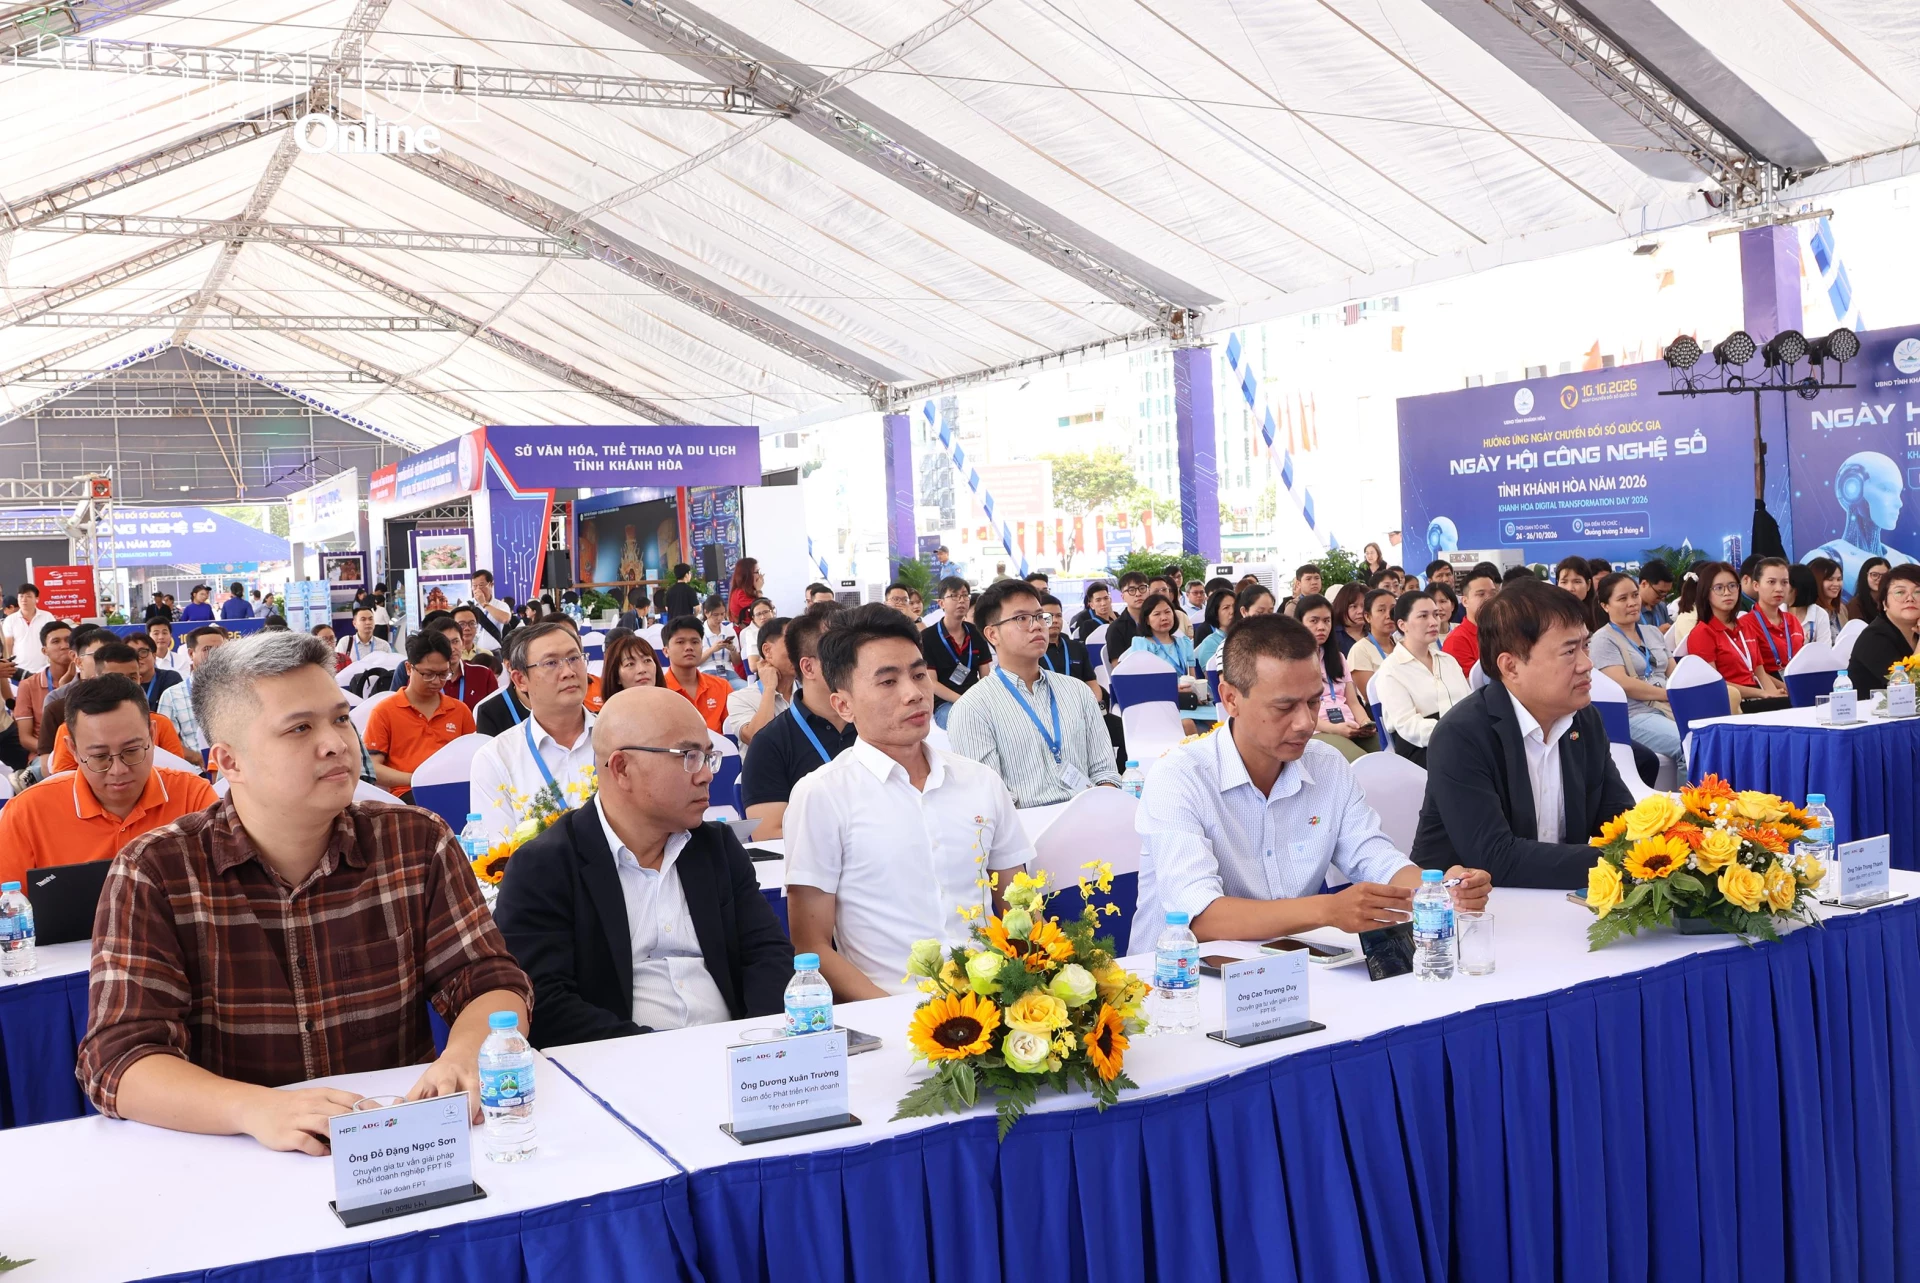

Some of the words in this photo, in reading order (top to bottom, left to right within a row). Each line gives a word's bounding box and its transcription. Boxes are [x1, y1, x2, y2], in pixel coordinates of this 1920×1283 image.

[1582, 379, 1637, 397] 10.10.2026
[1811, 402, 1895, 430] NGÀY
[1513, 434, 1529, 445] ỨNG
[1531, 430, 1553, 443] NGÀY
[1555, 425, 1586, 440] CHUYỂN
[1588, 423, 1602, 437] ĐỔI
[1605, 422, 1616, 435] SỐ
[1618, 420, 1643, 434] QUỐC
[1645, 420, 1661, 431] GIA
[1906, 428, 1920, 445] TỈ
[515, 444, 532, 456] SỞ
[537, 445, 562, 456] VĂN
[568, 444, 598, 456] HÓA,
[602, 442, 626, 455] THỂ
[630, 446, 662, 455] THAO
[667, 444, 683, 455] VÀ
[688, 446, 704, 455] DU
[709, 446, 736, 457] LỊCH
[1450, 454, 1501, 475] NGÀY
[1507, 449, 1538, 472] HỘI
[1544, 445, 1600, 467] CÔNG
[1607, 435, 1667, 461] NGHỆ
[1675, 428, 1707, 455] SỐ
[573, 459, 604, 471] TỈNH
[609, 459, 652, 470] KHÁNH
[658, 459, 683, 470] HÒA
[1498, 481, 1520, 497] TỈNH
[1523, 479, 1559, 496] KHÁNH
[1562, 477, 1587, 493] HÒA
[1589, 476, 1616, 491] NĂM
[1619, 475, 1647, 489] 2026
[1499, 504, 1519, 512] KHANH
[1535, 502, 1557, 510] DIGITAL
[1558, 498, 1614, 508] TRANSFORMATION
[1616, 497, 1630, 505] DAY
[1631, 496, 1648, 504] 2026
[141, 520, 188, 535] NGHỆ
[193, 518, 216, 533] SỐ
[1624, 527, 1639, 535] tháng
[1526, 531, 1557, 540] 26/10/2026
[126, 540, 148, 549] NĂM
[150, 540, 171, 548] 2026
[1264, 987, 1284, 995] Trương
[1237, 1004, 1254, 1012] Chuyên
[741, 1081, 757, 1090] Ông
[760, 1079, 786, 1087] Dương
[789, 1074, 808, 1082] Xuân
[811, 1071, 838, 1079] Trường
[760, 1092, 771, 1100] đốc
[789, 1087, 803, 1095] triển
[820, 1082, 839, 1090] doanh
[349, 1154, 368, 1163] Ông
[371, 1149, 383, 1159] Đỗ
[386, 1146, 409, 1156] Đặng
[412, 1142, 435, 1152] Ngọc
[438, 1138, 456, 1146] Sơn
[353, 1166, 382, 1178] Chuyên
[384, 1164, 395, 1173] gia
[407, 1158, 420, 1168] vấn
[422, 1155, 435, 1166] giải
[437, 1152, 454, 1164] pháp
[356, 1175, 373, 1185] Khối
[376, 1172, 398, 1181] doanh
[401, 1167, 425, 1179] nghiệp
[427, 1163, 442, 1171] FPT
